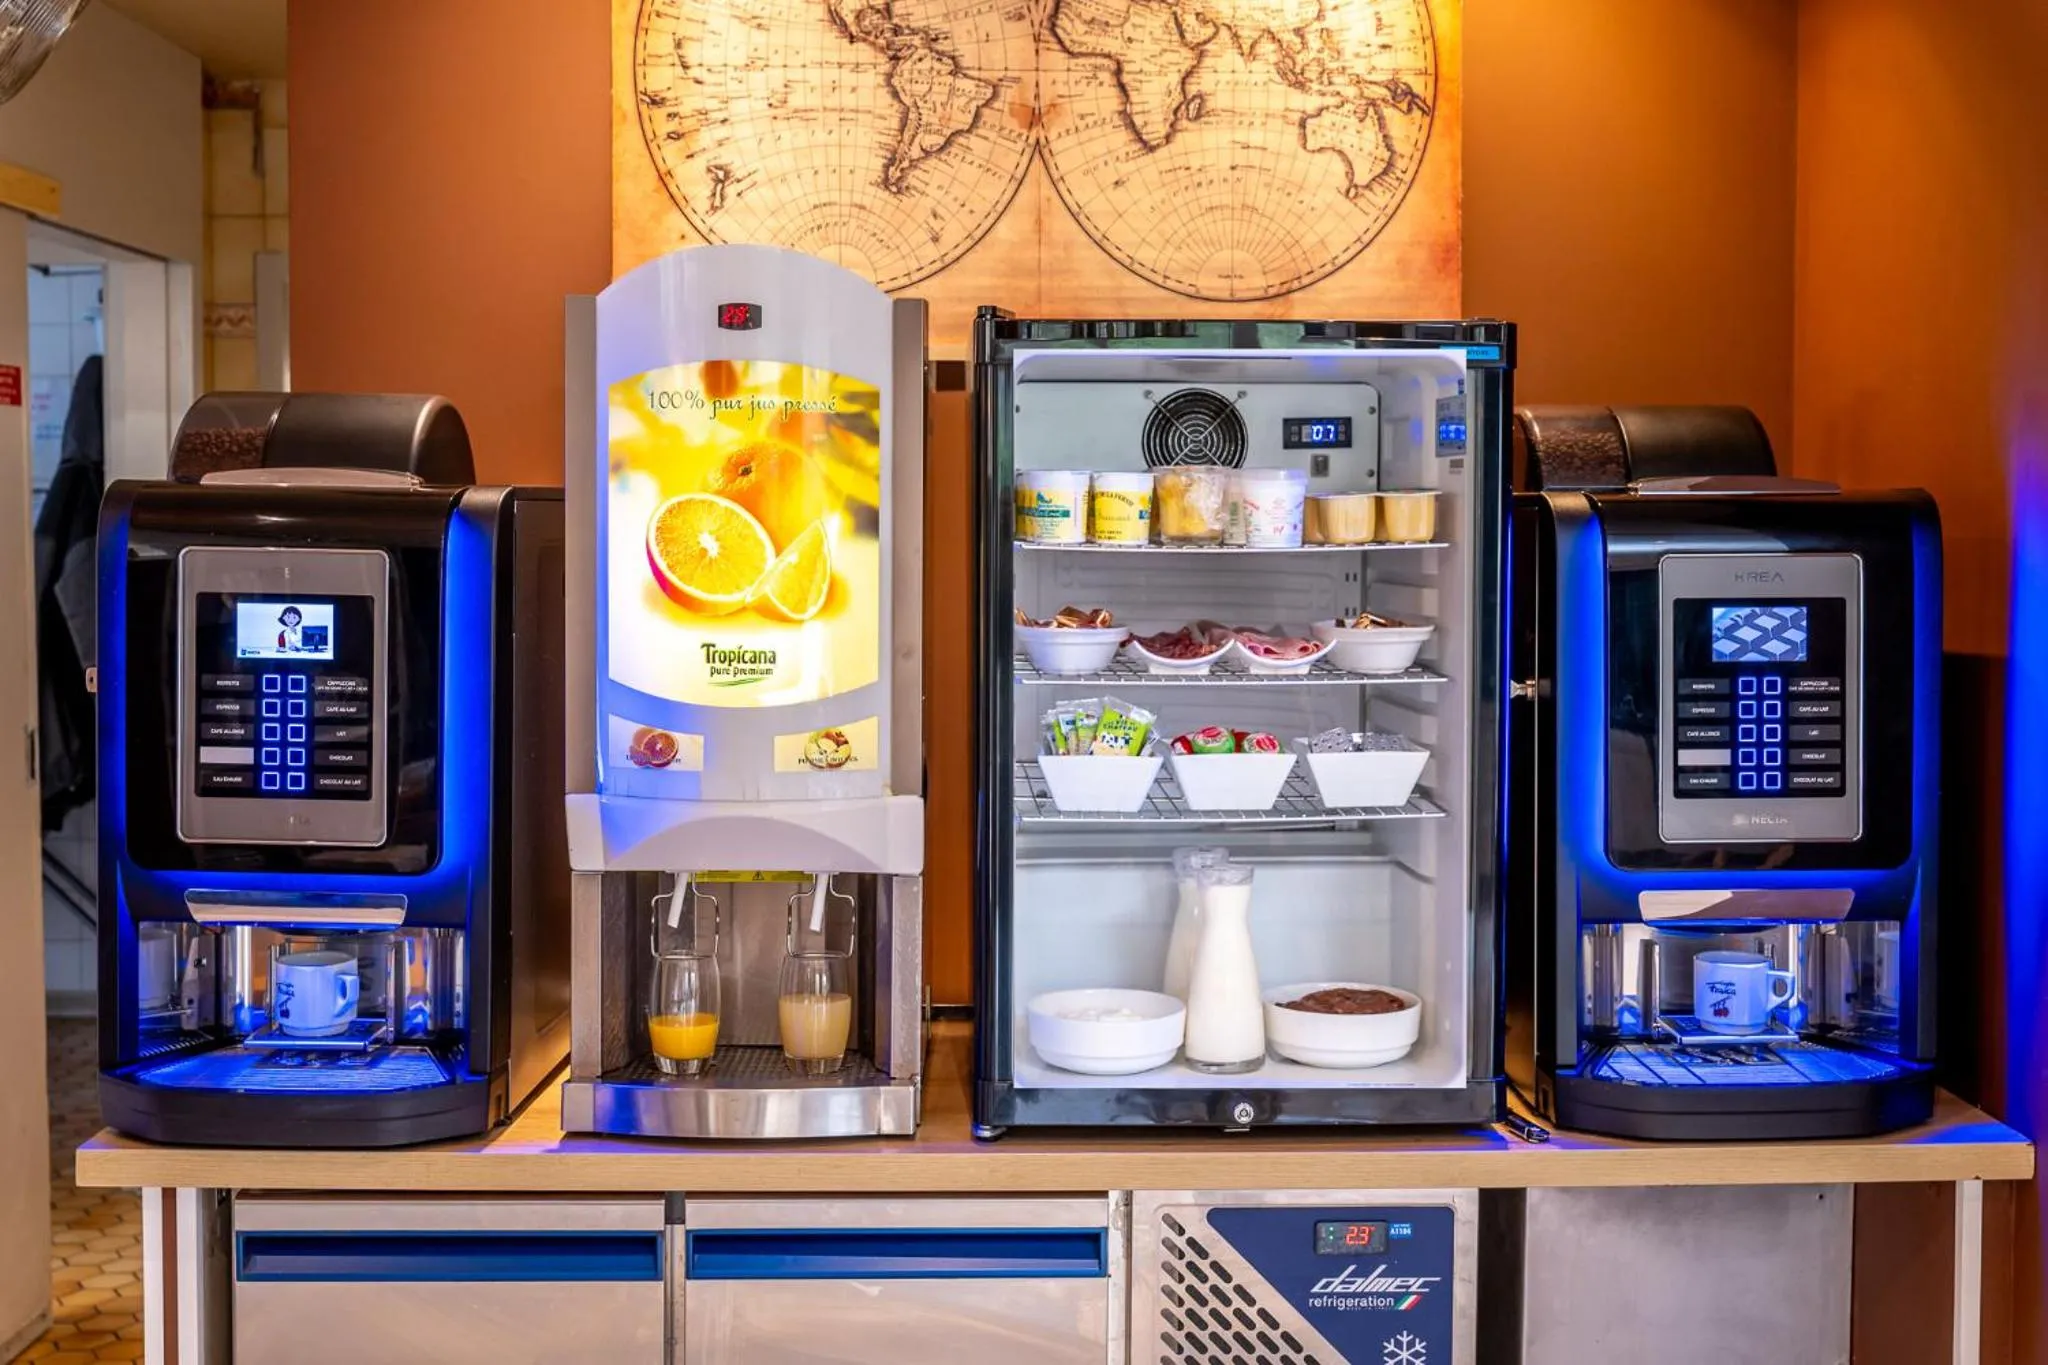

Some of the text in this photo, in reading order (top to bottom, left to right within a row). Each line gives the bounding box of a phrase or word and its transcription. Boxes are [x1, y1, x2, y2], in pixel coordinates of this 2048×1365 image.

[648, 389, 837, 421] 100% pur jus pressé
[700, 643, 776, 667] Tropicana
[1310, 1264, 1442, 1293] dalmec
[1309, 1294, 1395, 1311] refrigeration
